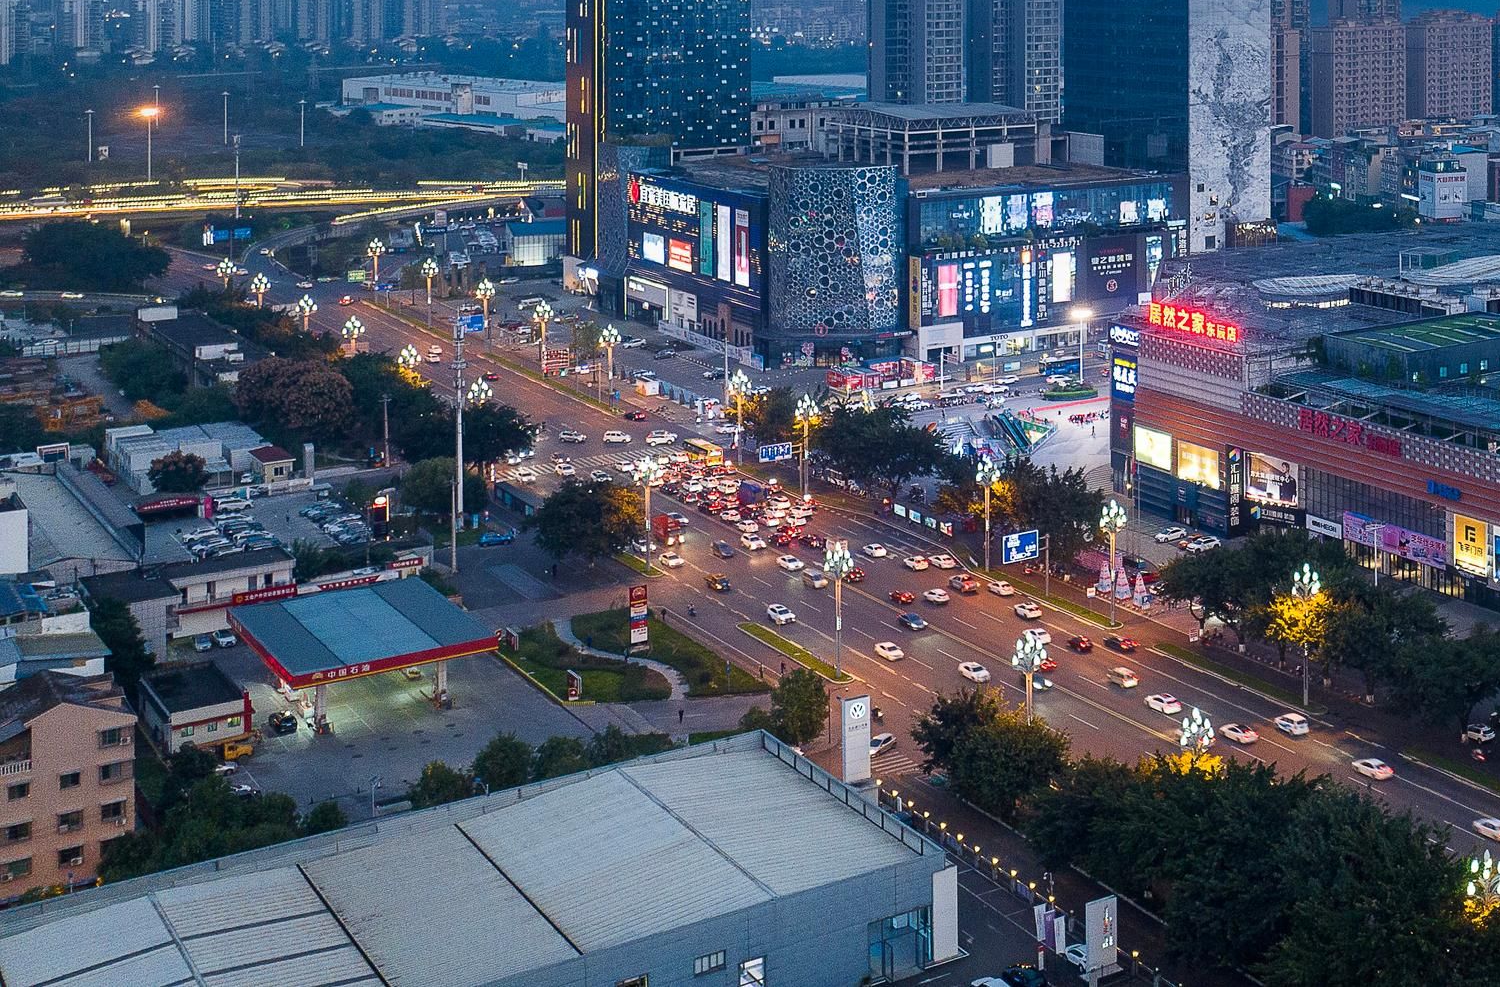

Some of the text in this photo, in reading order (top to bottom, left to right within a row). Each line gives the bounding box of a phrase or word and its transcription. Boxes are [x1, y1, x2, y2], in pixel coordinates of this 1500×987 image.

[1149, 302, 1205, 334] 居然之家
[990, 333, 1009, 341] TOTO
[1299, 407, 1362, 446] 居然之家
[327, 664, 370, 679] 中国石油
